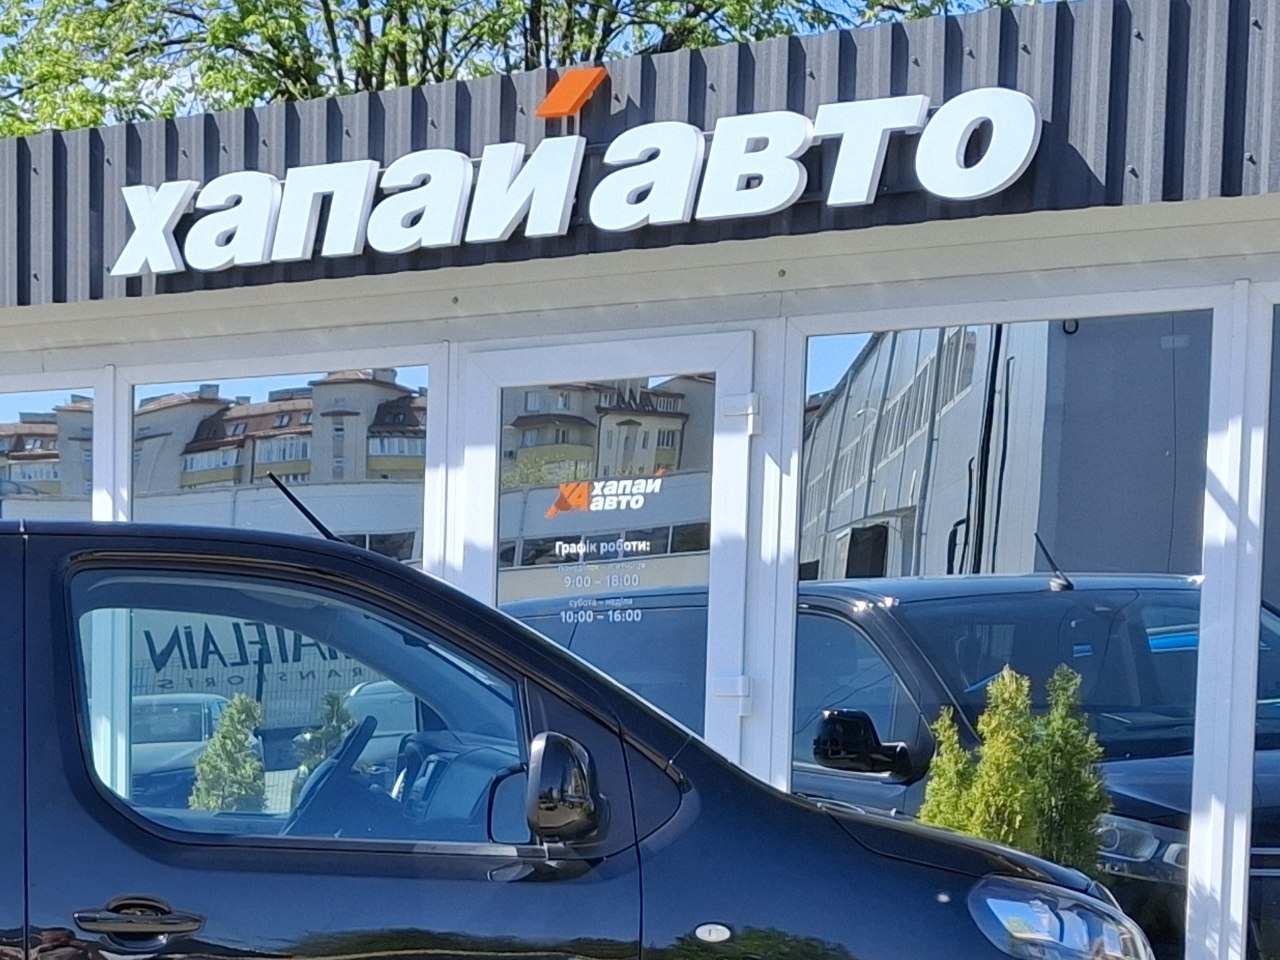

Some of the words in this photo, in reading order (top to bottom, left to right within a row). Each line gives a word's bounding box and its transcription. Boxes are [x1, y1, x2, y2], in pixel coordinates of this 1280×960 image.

[591, 467, 666, 495] хапай
[589, 495, 645, 511] авто
[555, 540, 597, 557] Графік
[600, 538, 651, 555] роботи:
[564, 575, 591, 588] 9:00
[606, 574, 639, 587] 18:00
[560, 610, 593, 623] 10:00
[607, 609, 642, 622] 16:00
